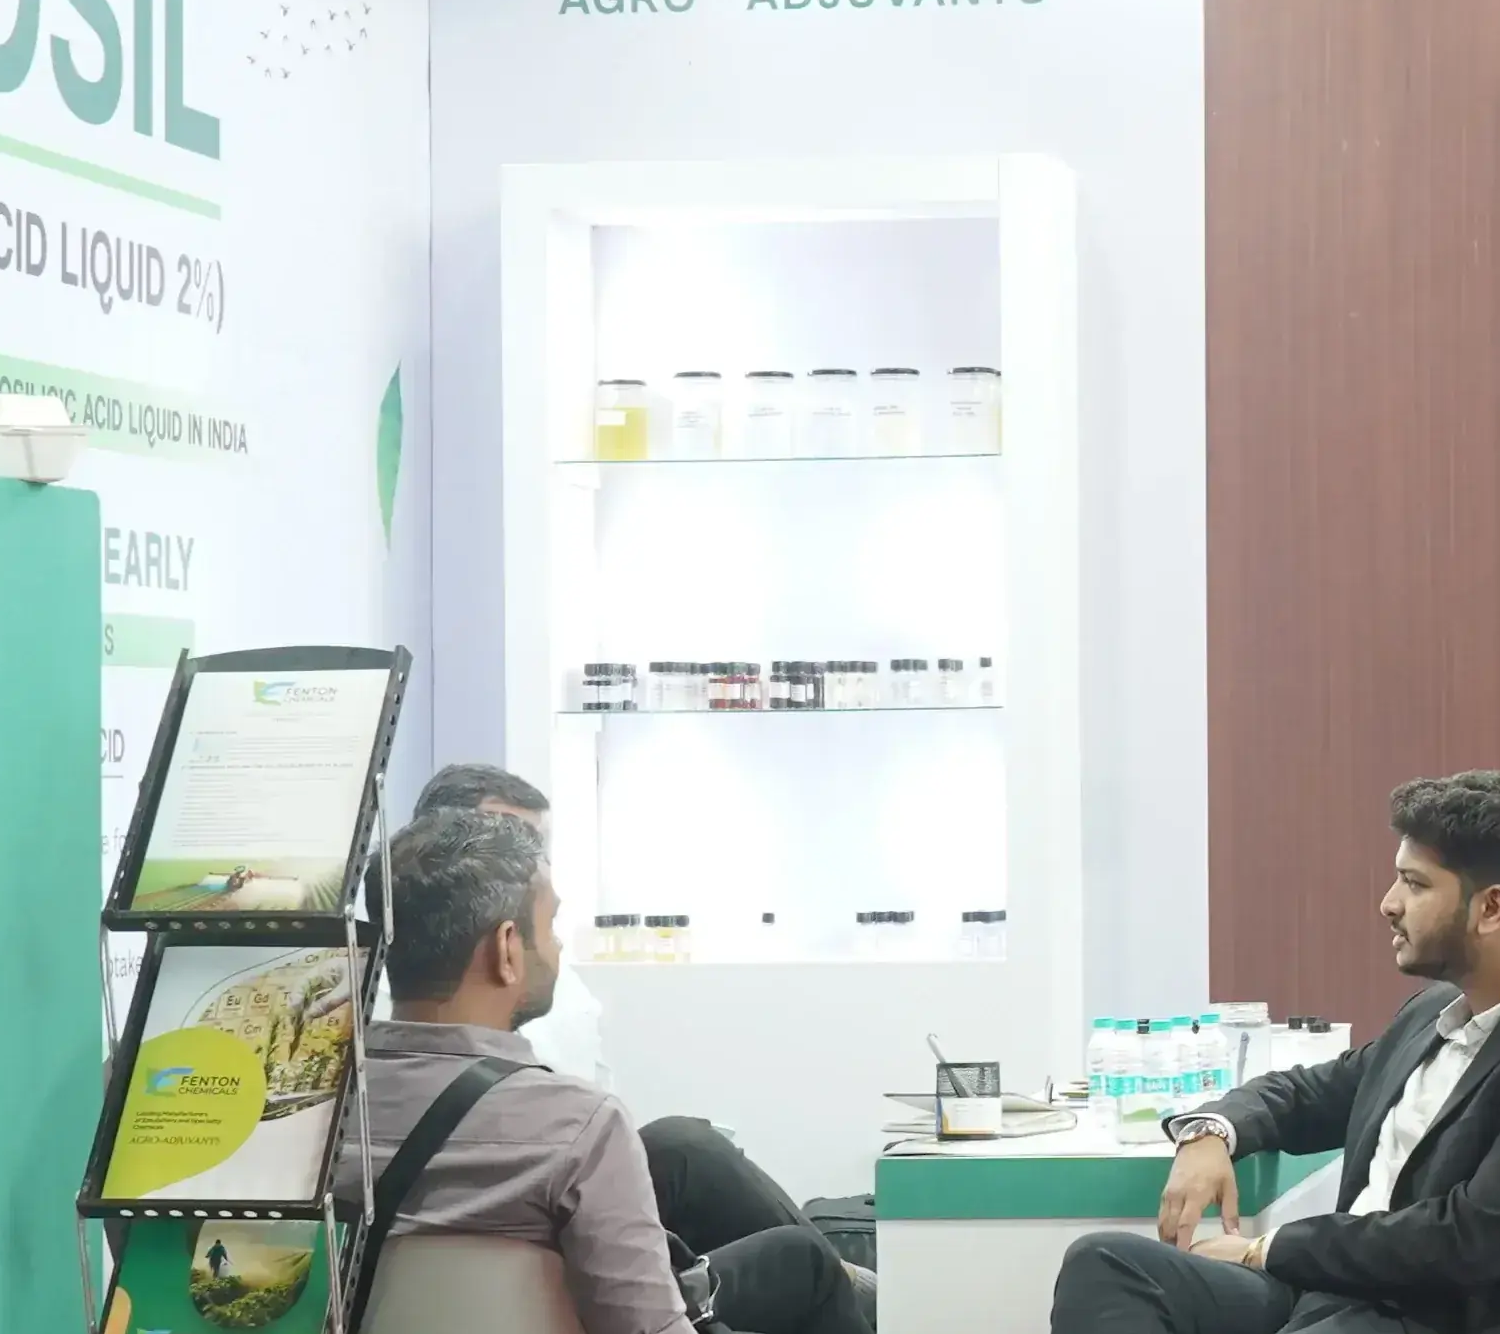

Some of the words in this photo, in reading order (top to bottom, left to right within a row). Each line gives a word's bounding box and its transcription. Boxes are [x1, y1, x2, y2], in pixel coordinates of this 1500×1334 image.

[61, 222, 165, 314] LIQUID
[177, 255, 225, 334] 2%)
[83, 393, 124, 430] ACID
[129, 401, 182, 447] LIQUID
[188, 411, 202, 447] IN
[208, 417, 249, 454] INDIA
[285, 687, 337, 696] FENTON
[226, 995, 241, 1006] Eu
[254, 994, 269, 1004] Gd
[181, 1076, 240, 1087] FENTON
[178, 1087, 237, 1095] CHEMICALS
